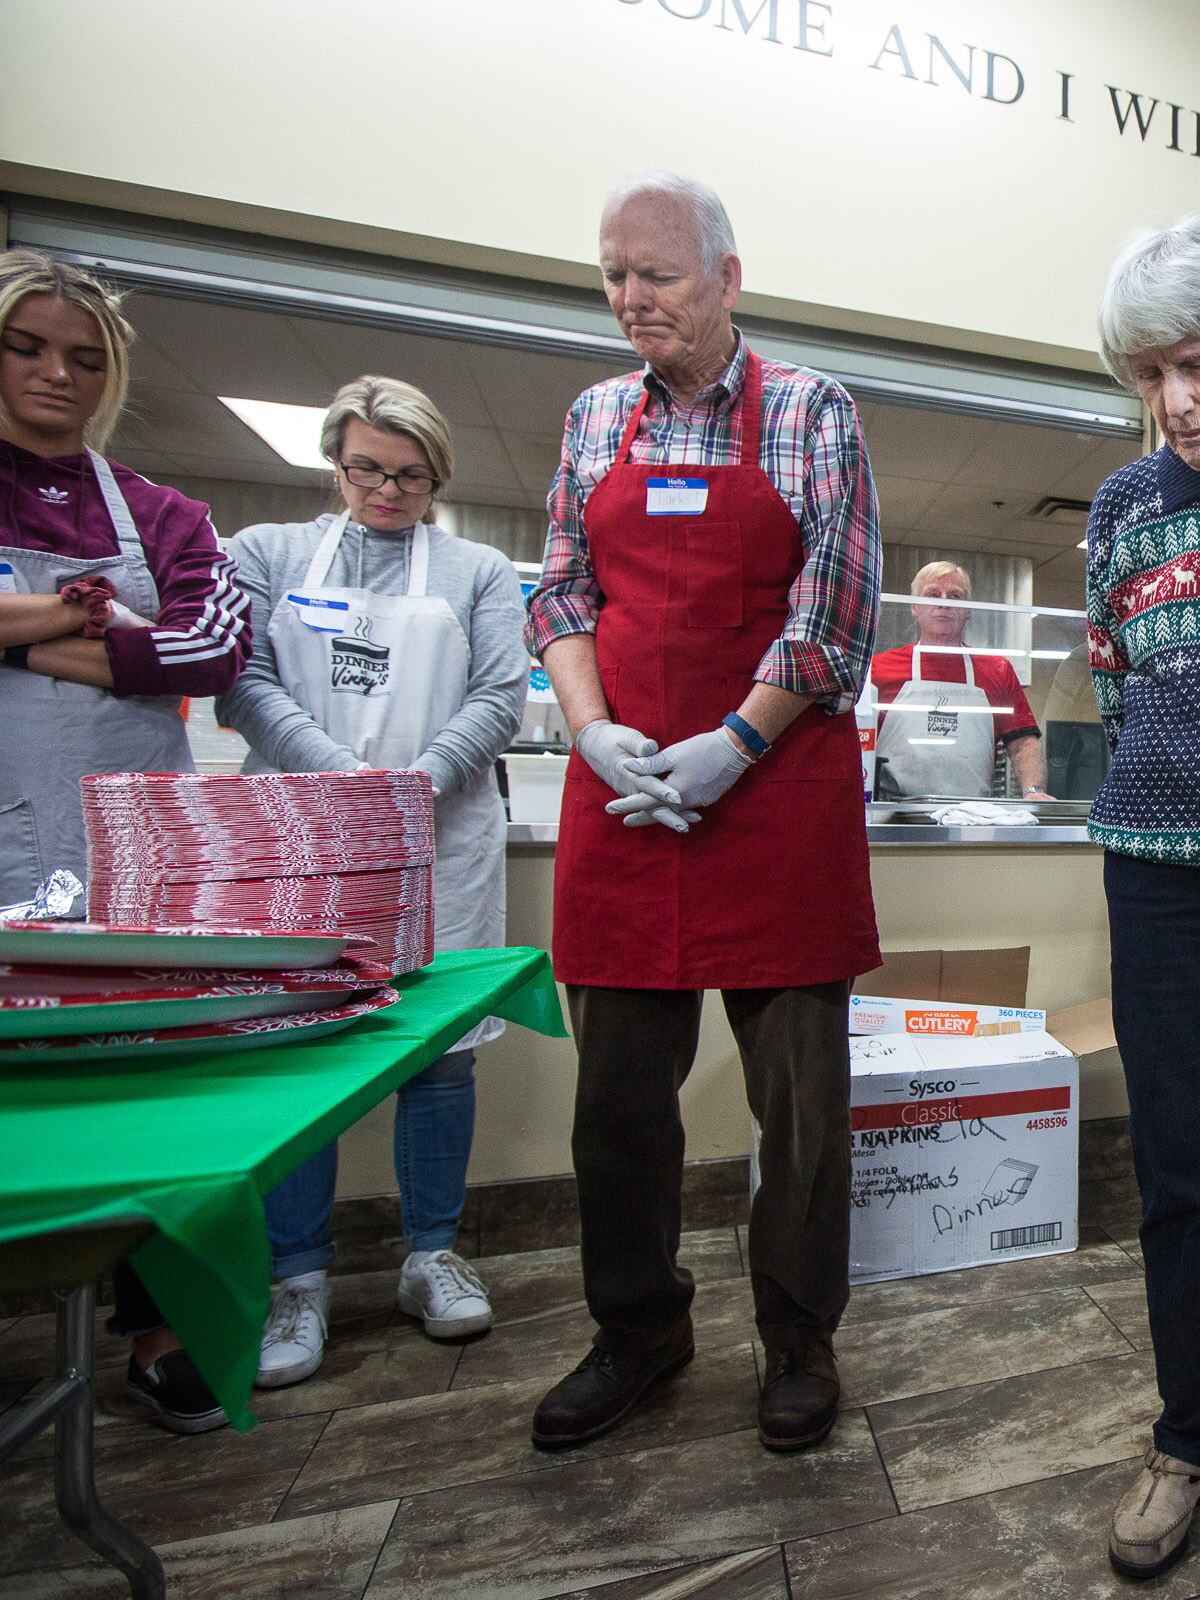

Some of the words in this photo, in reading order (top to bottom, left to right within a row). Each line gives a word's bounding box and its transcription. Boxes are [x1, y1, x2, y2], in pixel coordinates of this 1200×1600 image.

[616, 0, 834, 57] ME
[868, 23, 1025, 104] AND
[1055, 69, 1075, 123] I
[667, 478, 687, 486] Hello
[331, 654, 390, 672] DINNER
[331, 666, 390, 695] Vinny's
[928, 715, 959, 724] DINNER
[998, 1009, 1014, 1017] 360
[1015, 1010, 1044, 1020] PIECES
[908, 1016, 972, 1031] CUTLERY
[909, 1079, 957, 1099] Sysco
[901, 1101, 963, 1125] Classic
[1025, 1116, 1068, 1132] 4458596
[861, 1125, 941, 1148] NAPKINS
[856, 1168, 871, 1178] 1/4
[872, 1166, 898, 1176] FOLD
